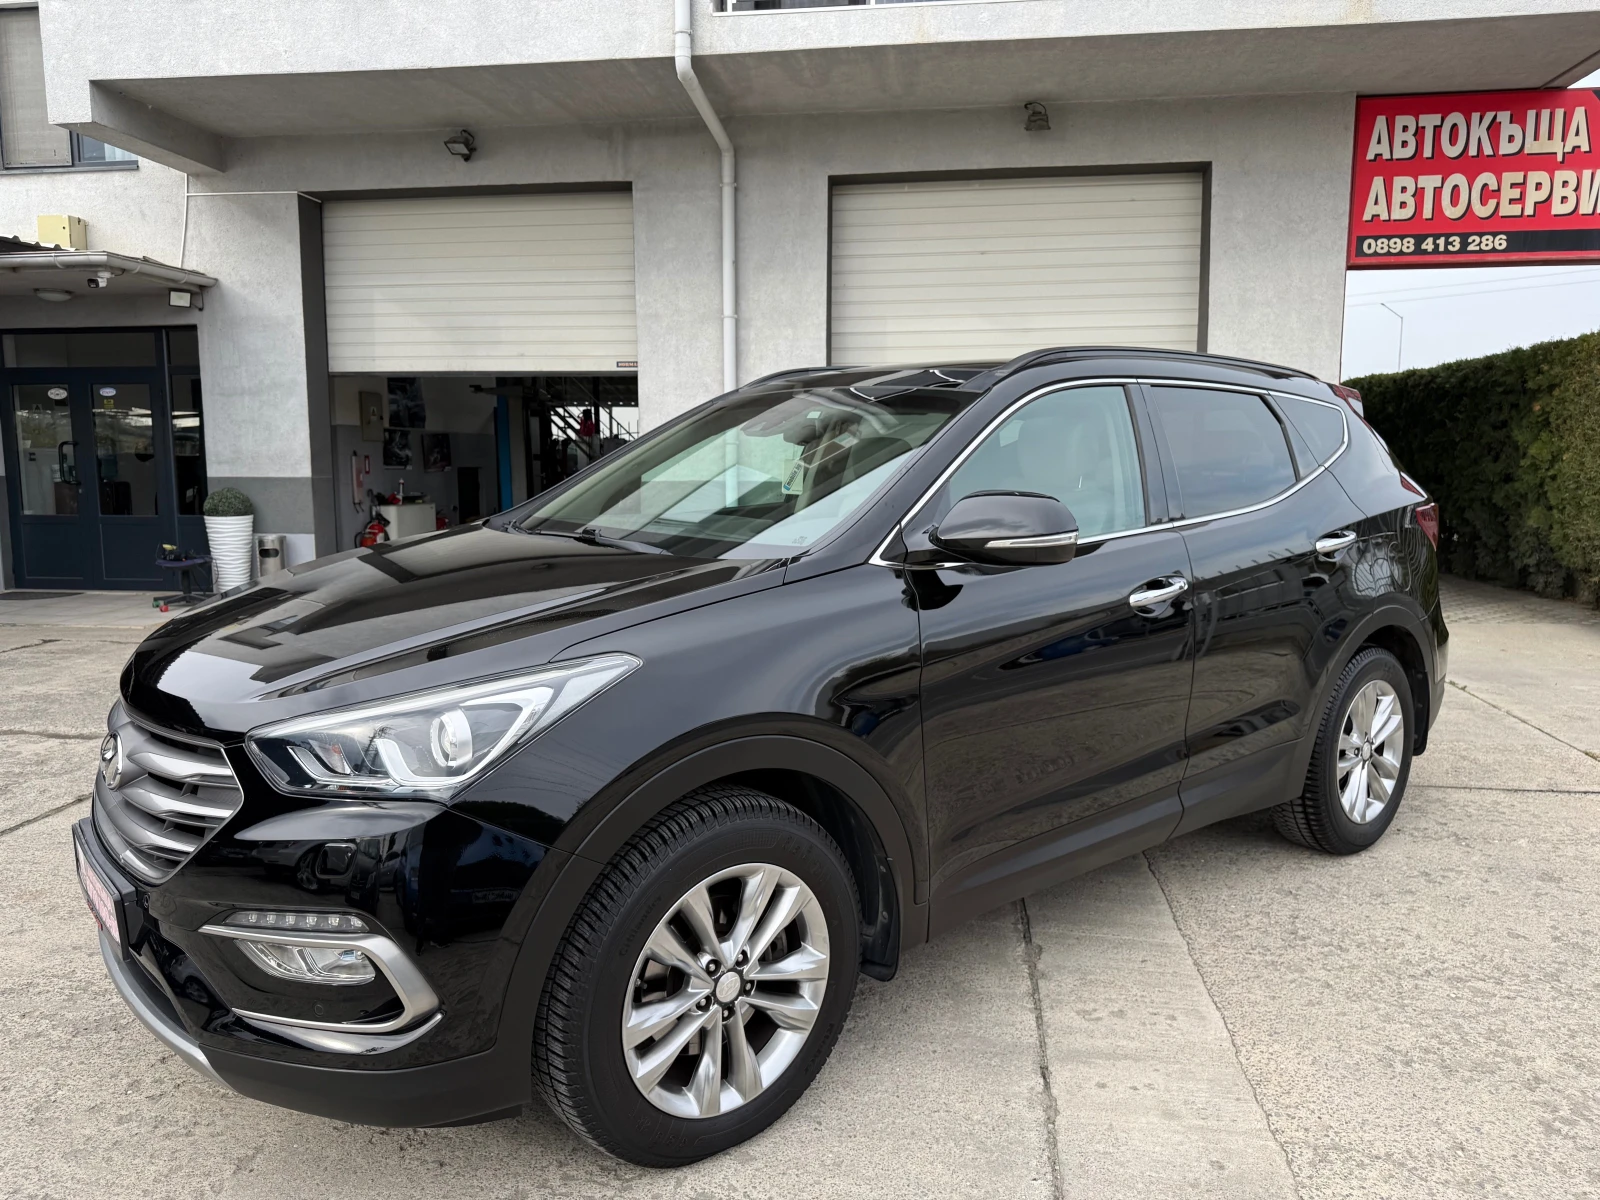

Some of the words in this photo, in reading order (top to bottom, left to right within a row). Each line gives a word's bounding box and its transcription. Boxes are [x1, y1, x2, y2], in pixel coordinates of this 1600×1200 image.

[1366, 106, 1591, 162] АВТОКЪЩА
[1362, 169, 1600, 221] АВТОСЕРВИ
[1362, 237, 1415, 254] 0898
[1421, 236, 1460, 252] 413
[1467, 234, 1507, 251] 286
